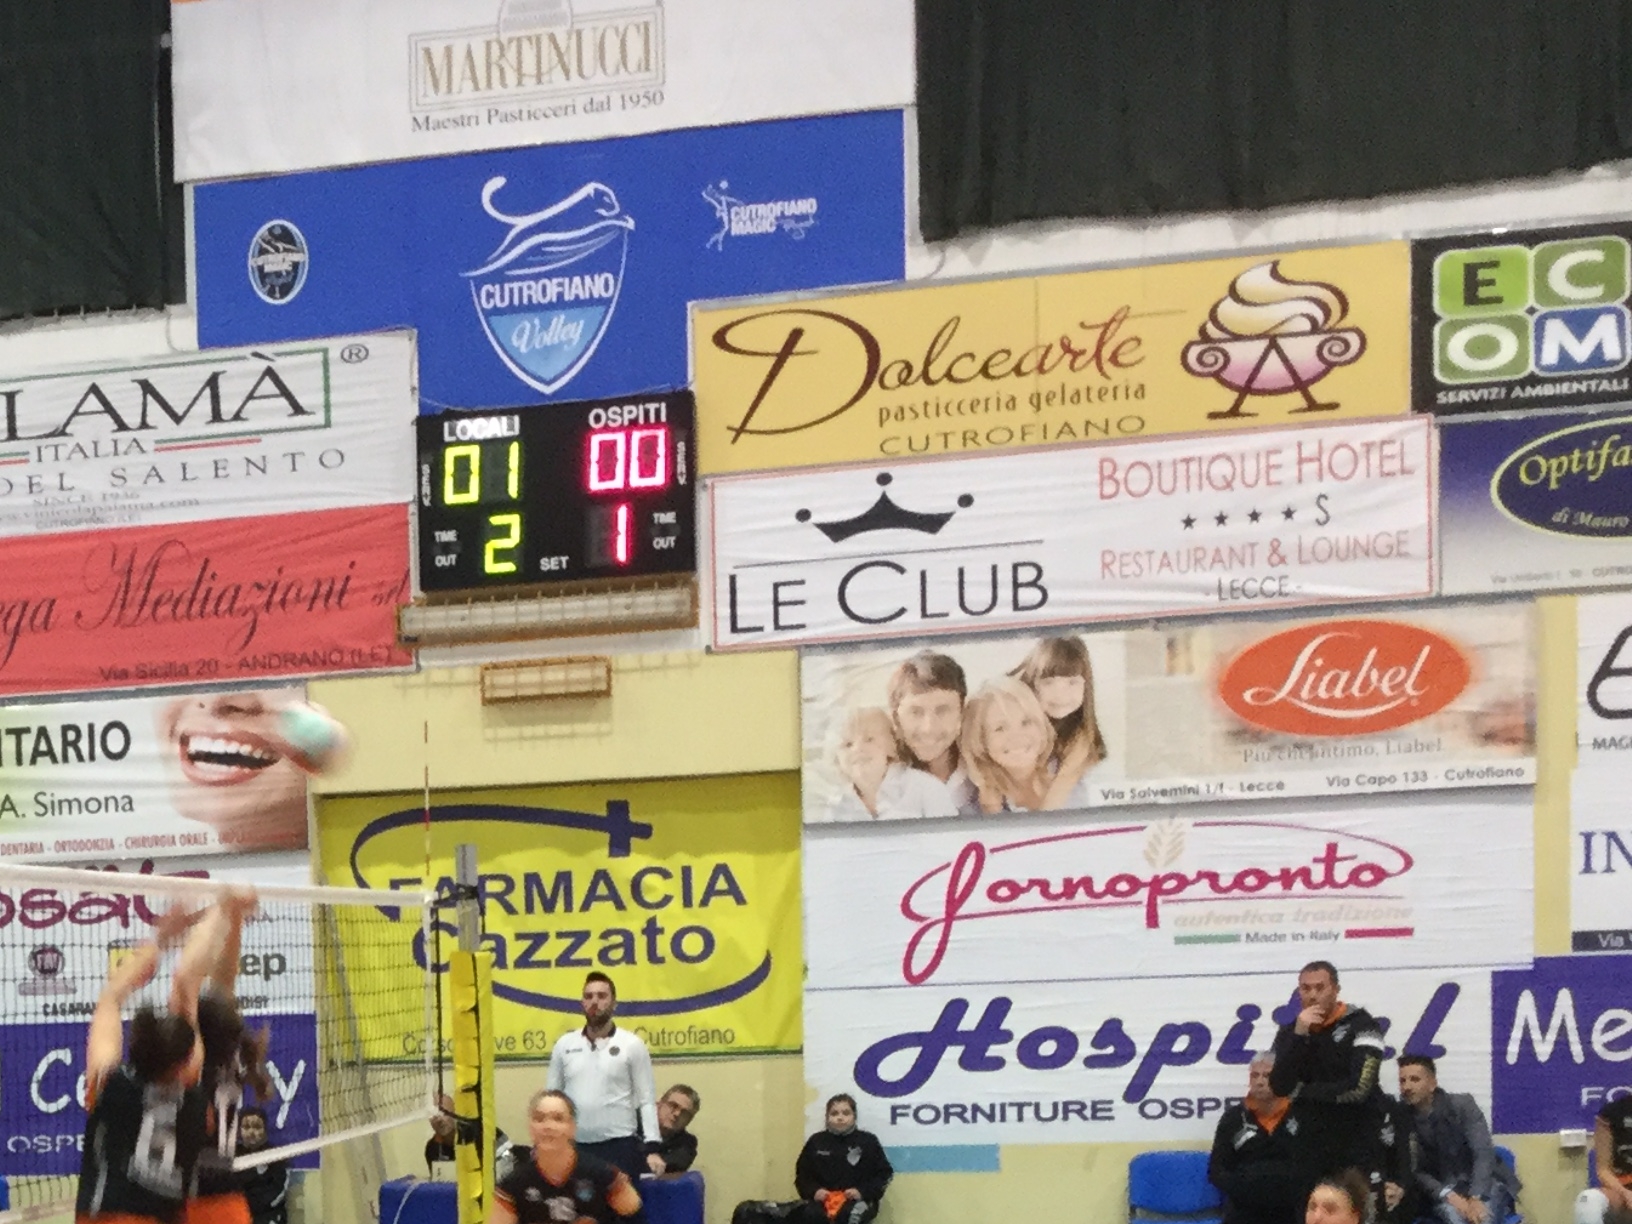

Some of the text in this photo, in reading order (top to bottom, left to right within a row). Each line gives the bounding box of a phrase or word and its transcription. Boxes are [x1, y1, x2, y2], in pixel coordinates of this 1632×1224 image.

[421, 20, 652, 98] MARTINUCCI
[411, 90, 665, 133] Maestri Pasticceri dal 1950
[730, 197, 818, 220] CUTROFIANO
[480, 272, 615, 310] CUTROFIANO
[511, 313, 585, 354] Volley
[712, 304, 1146, 445] Dolcearte
[1436, 378, 1629, 404] SERVIZI AMBIENTALI
[878, 381, 1146, 426] pasticceria gelateria
[444, 402, 667, 442] LOCALI OSPITI
[878, 415, 1146, 456] CUTROFIANO
[35, 436, 148, 464] ITALIA
[110, 447, 348, 489] SALENTO
[444, 428, 667, 505] 01 00
[1097, 440, 1416, 502] BOUTIQUE HOTEL
[653, 512, 676, 524] TIME
[1315, 493, 1331, 527] S
[1552, 507, 1629, 527] di Mauro
[434, 530, 458, 542] TIME
[484, 514, 520, 574] 2
[616, 504, 627, 563] 1
[653, 536, 676, 549] OUT
[435, 554, 457, 567] OUT
[539, 556, 569, 572] SET
[1100, 531, 1411, 581] RESTAURANT & LOUNGE
[74, 539, 357, 652] Mediazioni
[728, 558, 1049, 635] LE CLUB
[1215, 576, 1290, 602] LECCE
[98, 644, 394, 682] Via Sicilia 20 ANDRANO (LE)
[1243, 632, 1431, 706] Liabel
[1101, 788, 1124, 801] Via
[1129, 783, 1200, 799] Salvemini
[1240, 779, 1286, 793] Lecce
[1326, 765, 1526, 788] Via Capo 133 Cutrofiano
[34, 790, 135, 817] Simona
[179, 832, 208, 846] ORALE
[1245, 929, 1341, 944] Made in Italy
[1598, 933, 1625, 949] Via
[523, 1031, 546, 1050] 63
[854, 982, 1460, 1104] Hospil
[889, 1101, 1116, 1127] FORNITURE
